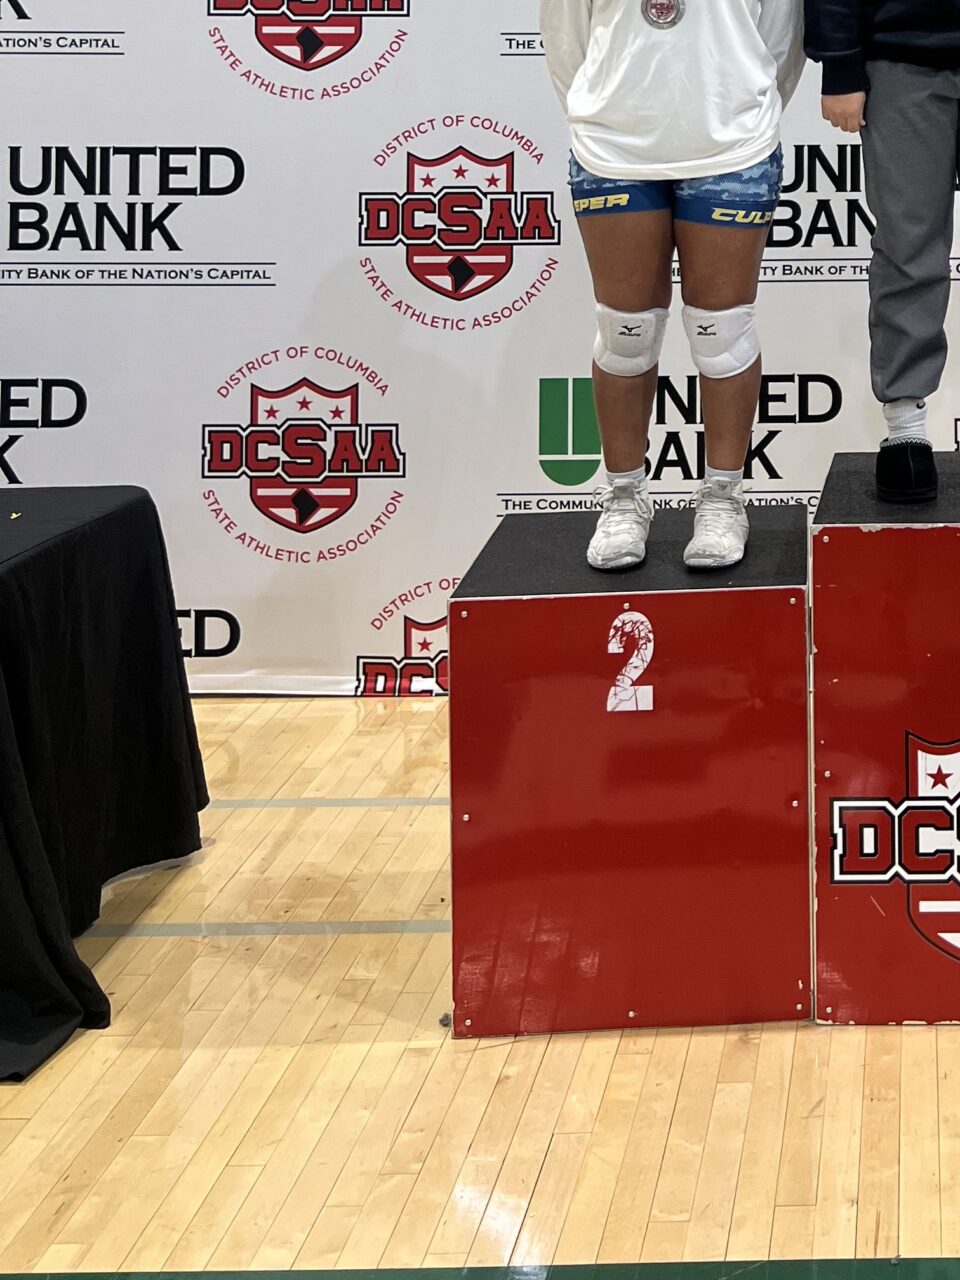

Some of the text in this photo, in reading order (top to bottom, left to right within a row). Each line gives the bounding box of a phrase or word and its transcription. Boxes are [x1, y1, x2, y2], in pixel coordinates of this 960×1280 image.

[208, 28, 407, 100] STATE ATHLETIC ASSOCIATION
[8, 146, 244, 196] UNITED
[374, 115, 543, 167] DISTRICT OF COLUMBIA
[7, 202, 182, 251] BANK
[358, 186, 561, 252] DCSAA
[28, 268, 70, 279] BANK
[75, 270, 95, 279] OF
[98, 270, 127, 279] THE
[132, 268, 203, 279] NATION'S
[208, 268, 271, 279] CAPITAL
[360, 257, 560, 332] STATE ATHLETIC ASSOCIATION
[218, 346, 389, 399] DISTRICT OF COLUMBIA
[202, 418, 406, 484] DCSAA
[202, 489, 403, 564] STATE ATHLETIC ASSOCIATION
[606, 611, 655, 712] 2
